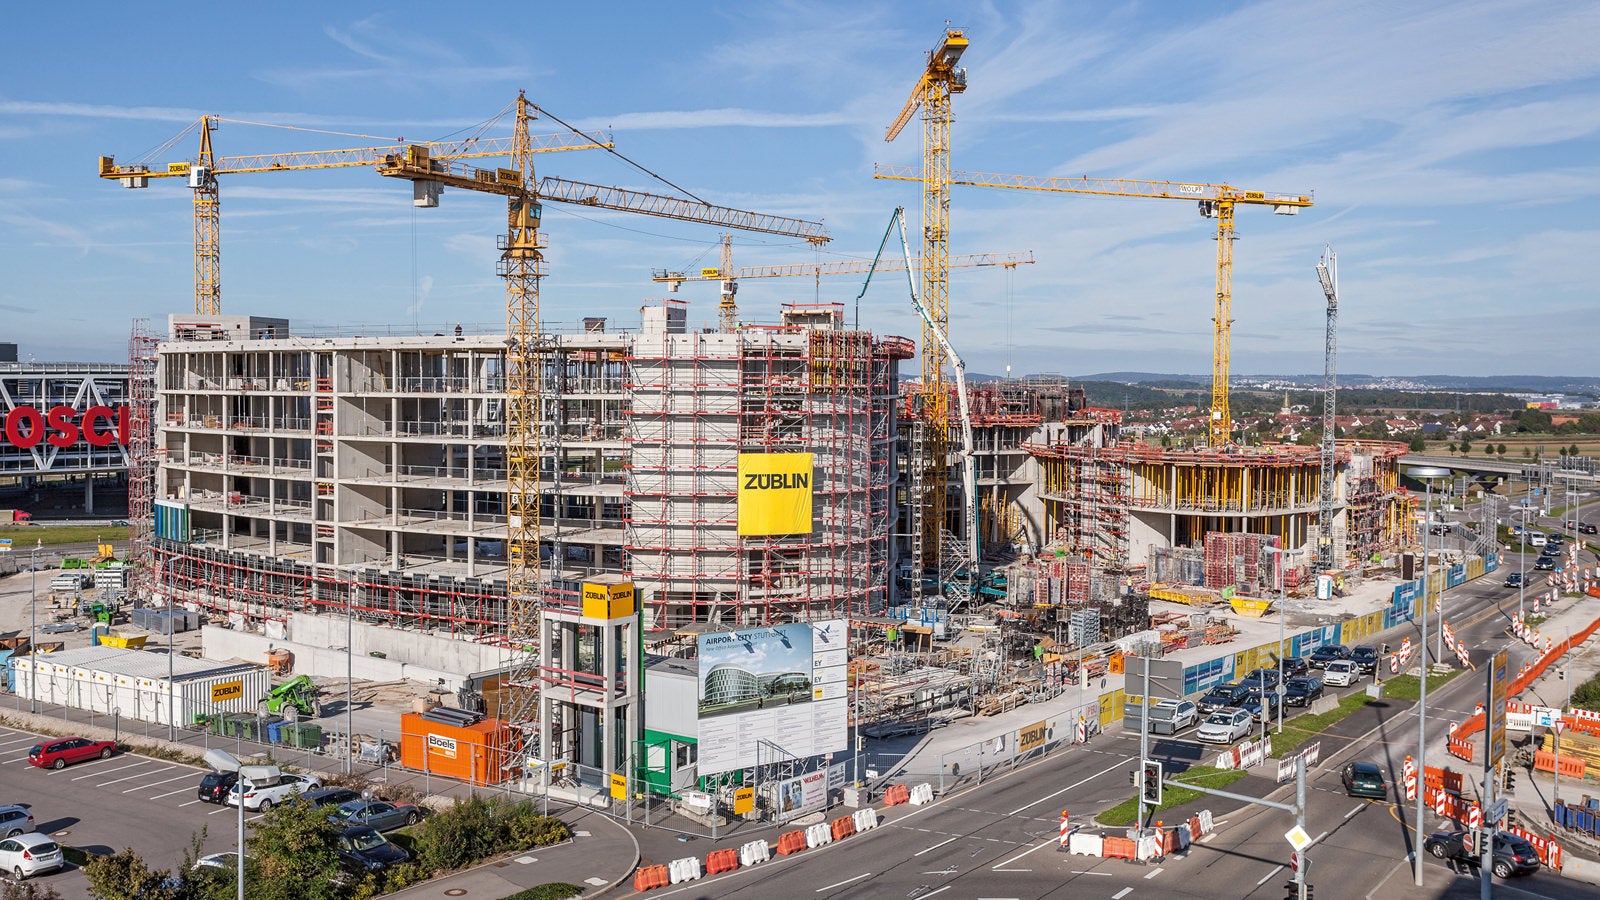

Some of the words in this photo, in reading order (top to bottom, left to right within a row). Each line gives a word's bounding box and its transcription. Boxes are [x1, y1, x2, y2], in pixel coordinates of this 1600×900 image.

[0, 405, 130, 448] OSC
[744, 473, 808, 490] ZÜBLIN
[586, 592, 606, 600] ZÜBLIN
[612, 590, 632, 600] ZÜBLIN
[1237, 654, 1244, 666] EY
[214, 686, 240, 696] ZÜBLIN
[1020, 726, 1046, 746] ZÜBLIN
[430, 736, 455, 750] Boels
